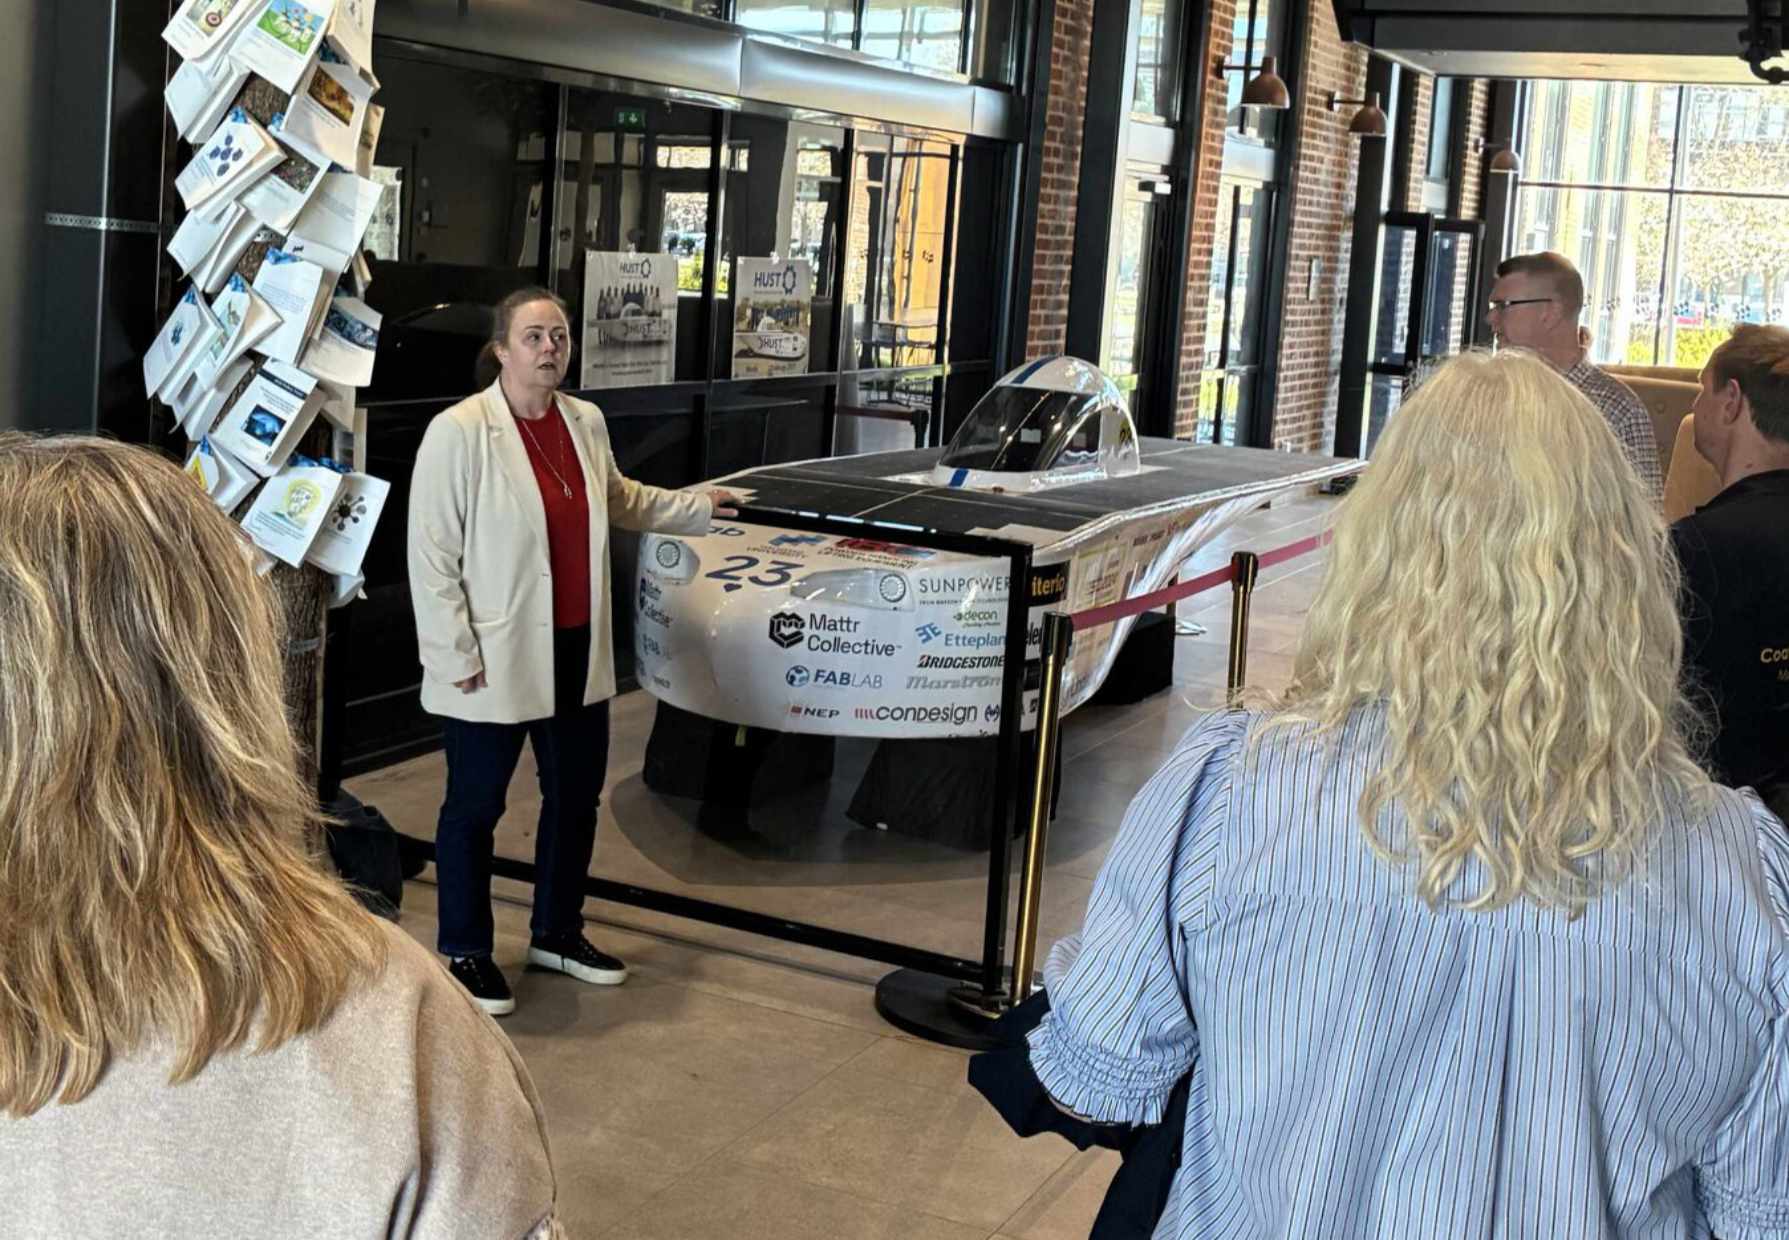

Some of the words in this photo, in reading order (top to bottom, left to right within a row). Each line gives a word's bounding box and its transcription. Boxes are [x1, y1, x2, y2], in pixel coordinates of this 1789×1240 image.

[620, 262, 640, 273] HUST
[754, 272, 782, 287] HUST
[705, 555, 804, 586] 23
[919, 576, 1010, 593] SUNPOWER
[809, 613, 861, 633] Mattr
[807, 634, 895, 656] Collective
[945, 632, 1007, 650] Etteplan
[917, 654, 1005, 669] BRIDGESTONE
[804, 707, 840, 718] NEP
